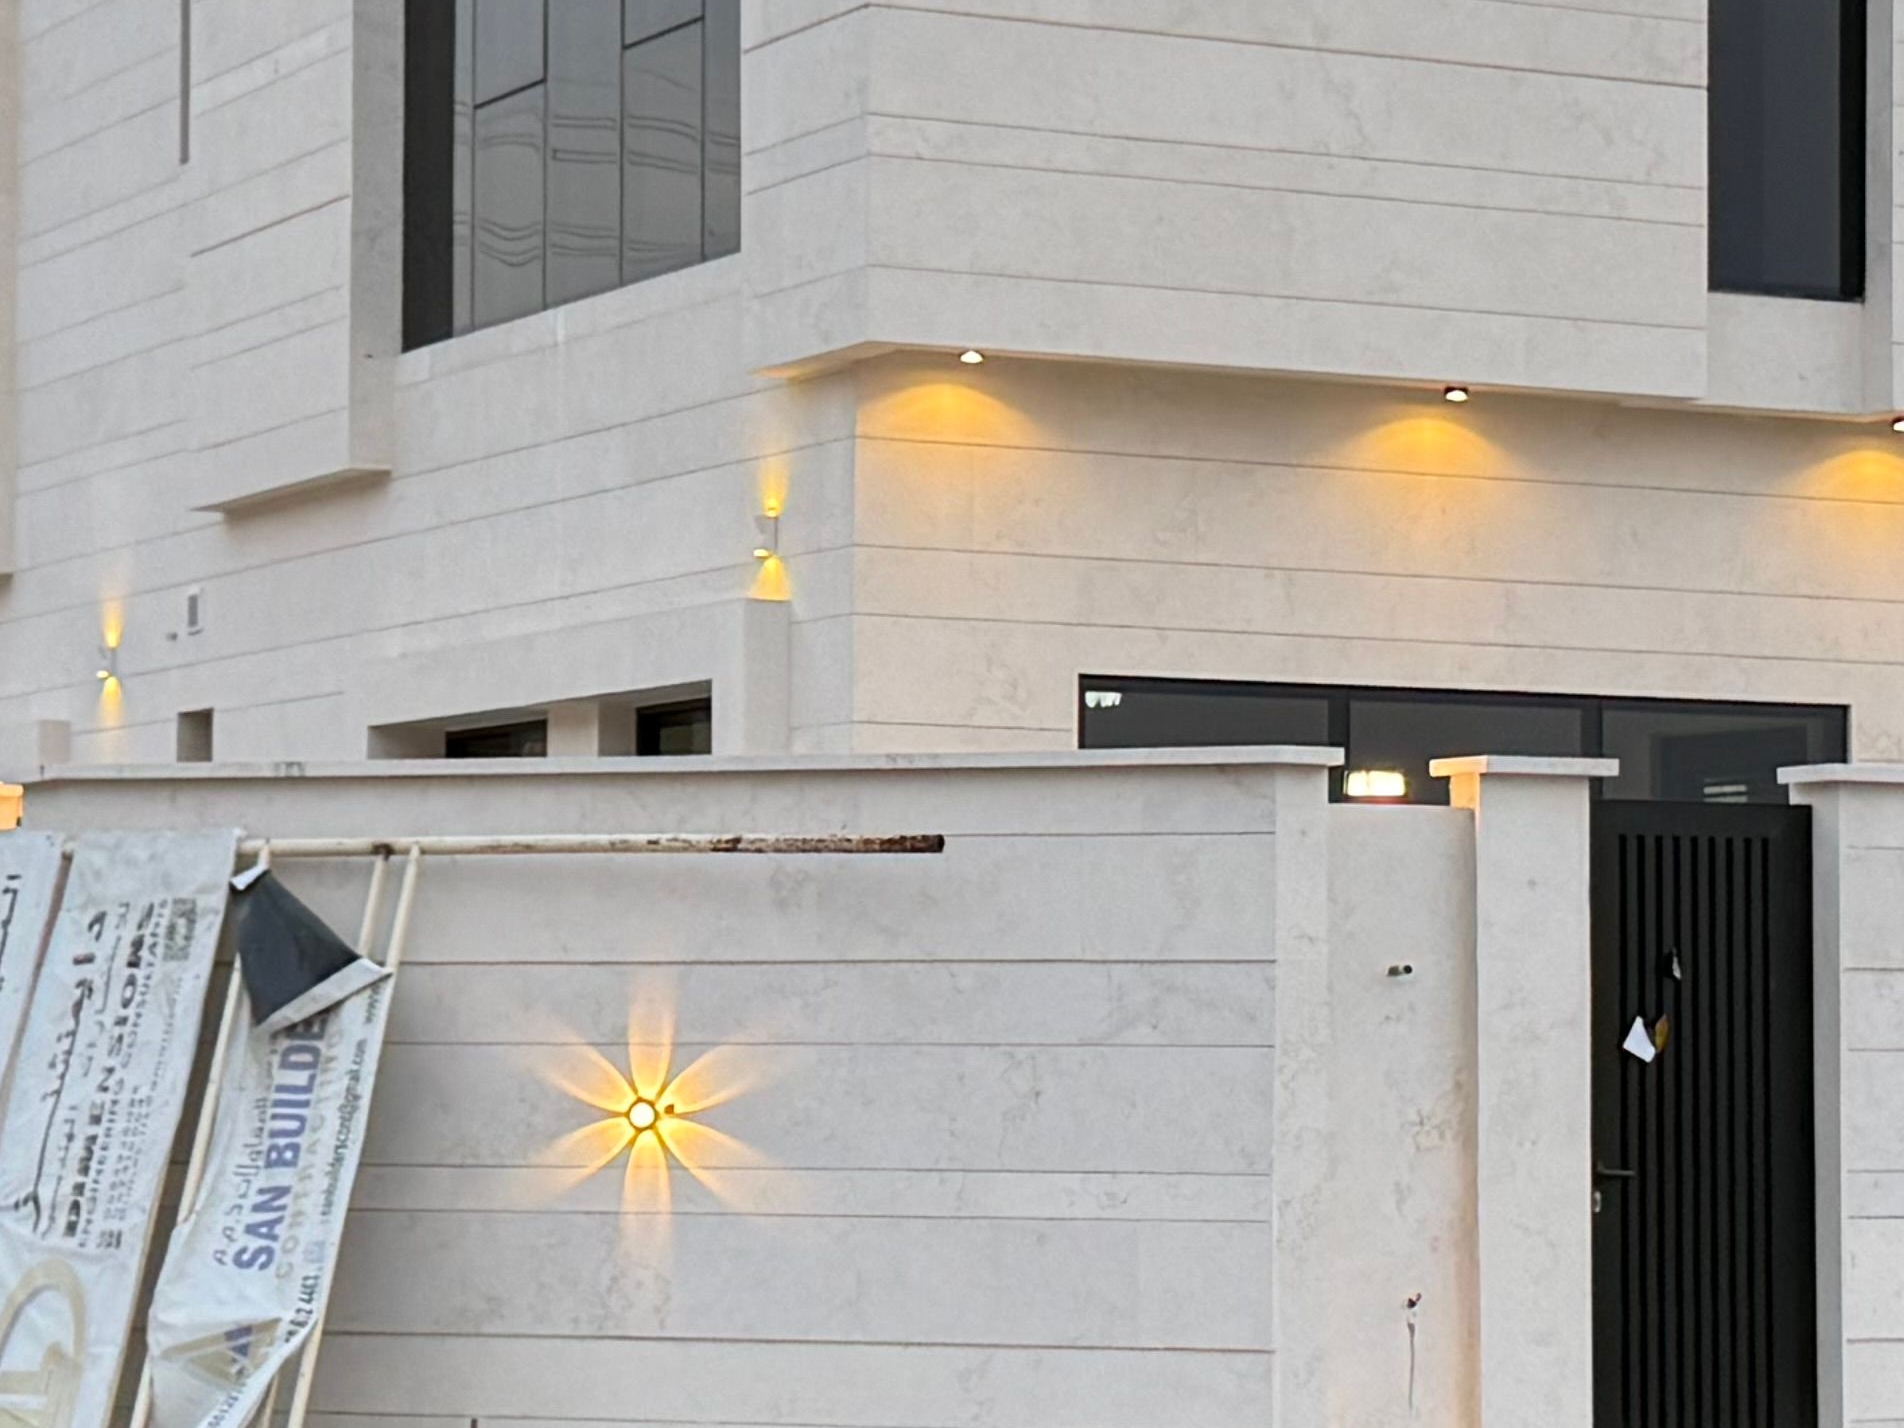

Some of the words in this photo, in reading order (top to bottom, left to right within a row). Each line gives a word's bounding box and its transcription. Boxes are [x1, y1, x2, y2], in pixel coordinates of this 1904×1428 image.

[64, 903, 154, 1237] DIMENSIONS
[232, 1185, 292, 1271] SAN
[265, 1017, 332, 1169] BUILDE
